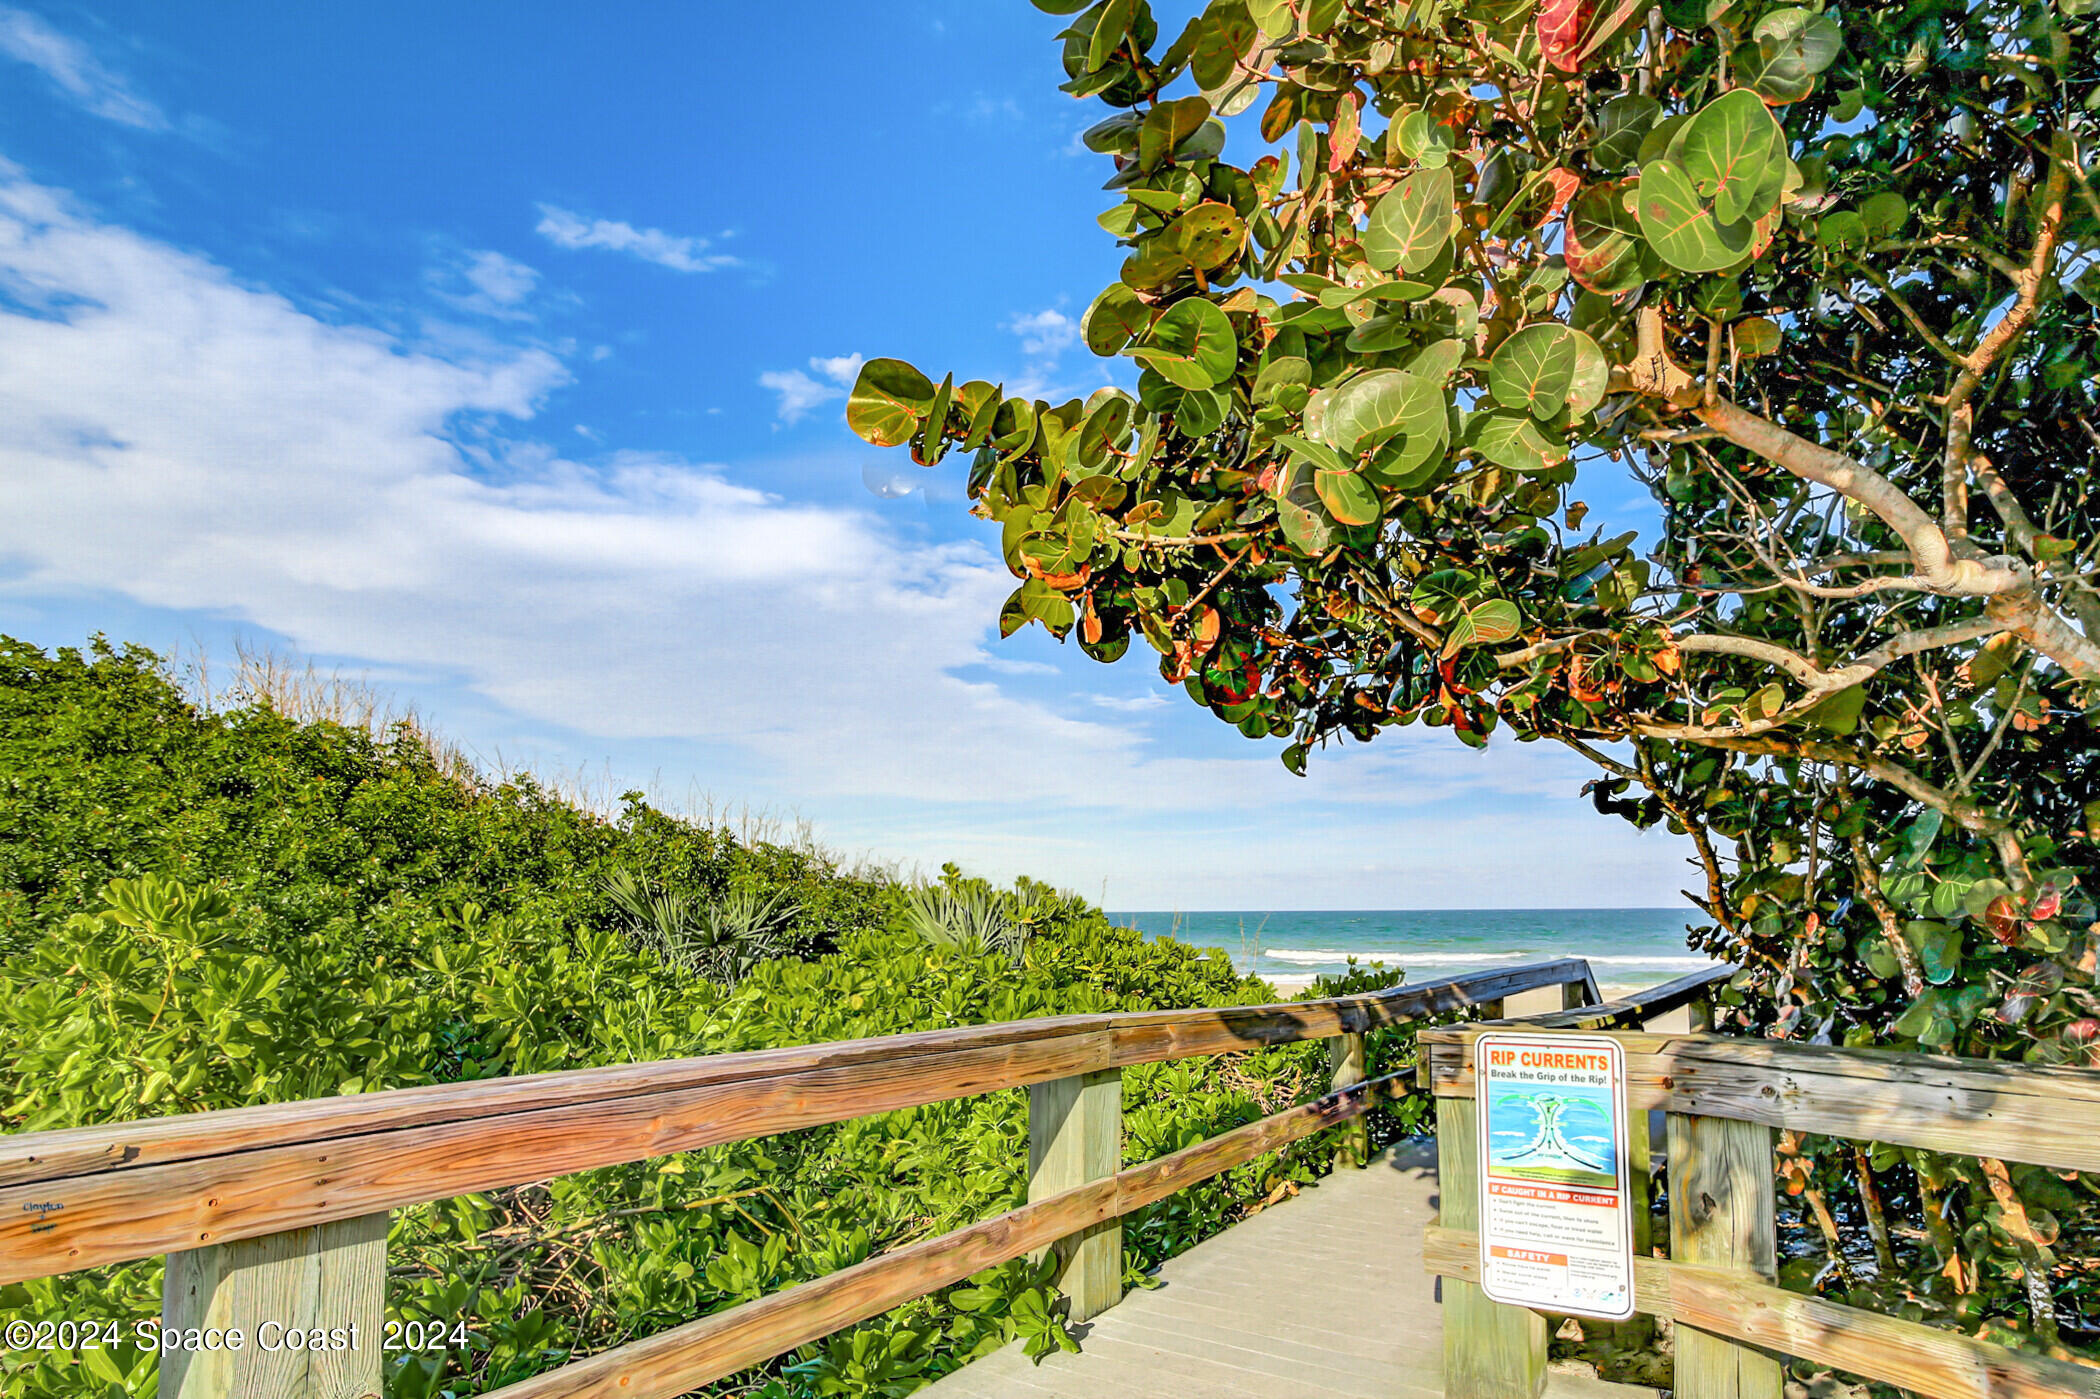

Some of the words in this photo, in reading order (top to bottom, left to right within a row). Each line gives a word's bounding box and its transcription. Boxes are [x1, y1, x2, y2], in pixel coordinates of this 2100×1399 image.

[1490, 1050, 1516, 1065] RIP
[1520, 1052, 1609, 1071] CURRENTS
[1491, 1069, 1517, 1078] Break
[1520, 1071, 1534, 1079] the
[1536, 1072, 1556, 1082] Grip
[1558, 1073, 1567, 1081] of
[1571, 1074, 1586, 1083] the
[1588, 1075, 1607, 1085] Rip!
[1491, 1185, 1499, 1193] IF
[1501, 1186, 1536, 1197] CAUGHT
[1537, 1189, 1547, 1198] IN
[1548, 1191, 1555, 1199] A
[1556, 1192, 1571, 1201] RIP
[1573, 1195, 1615, 1205] CURRENT
[1507, 1250, 1550, 1263] SAFETY
